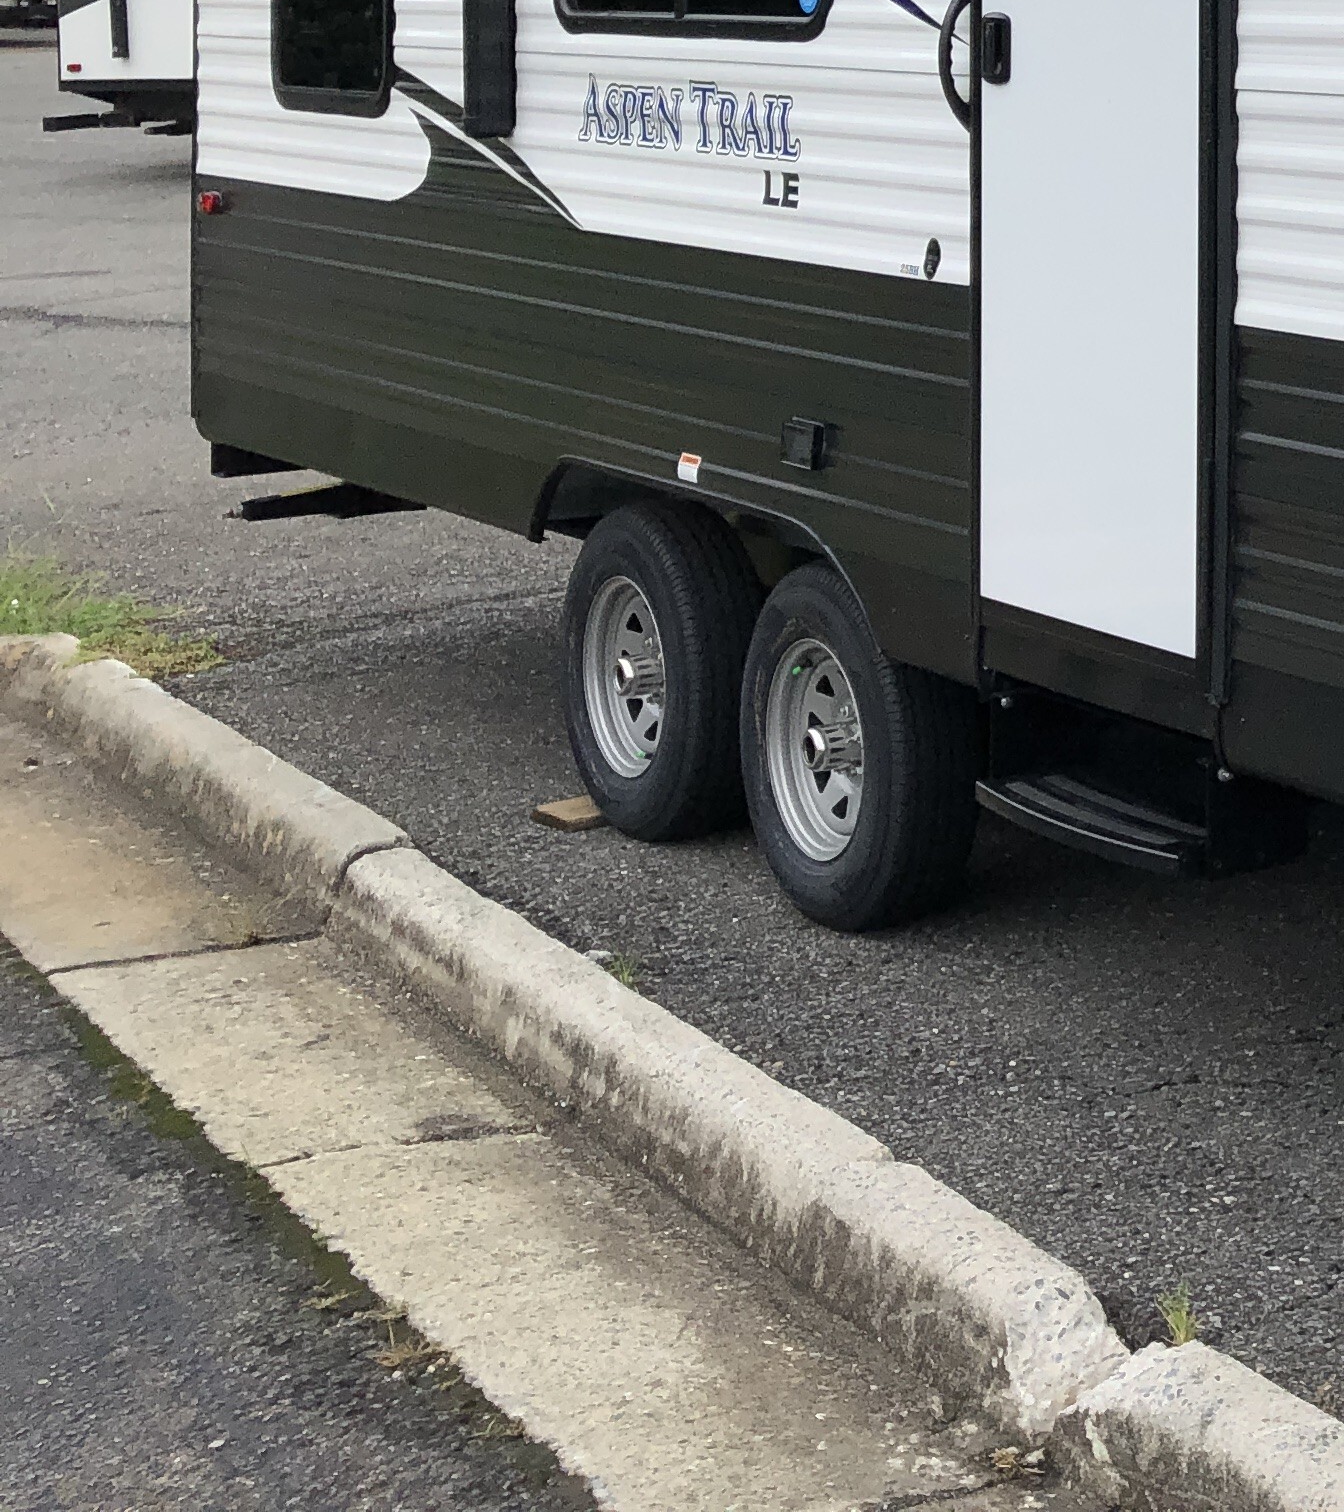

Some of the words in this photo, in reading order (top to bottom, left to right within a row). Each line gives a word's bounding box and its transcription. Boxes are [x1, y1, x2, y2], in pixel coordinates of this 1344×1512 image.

[578, 72, 683, 151] ASPEN
[689, 79, 801, 162] TRAIL
[762, 169, 800, 209] LE
